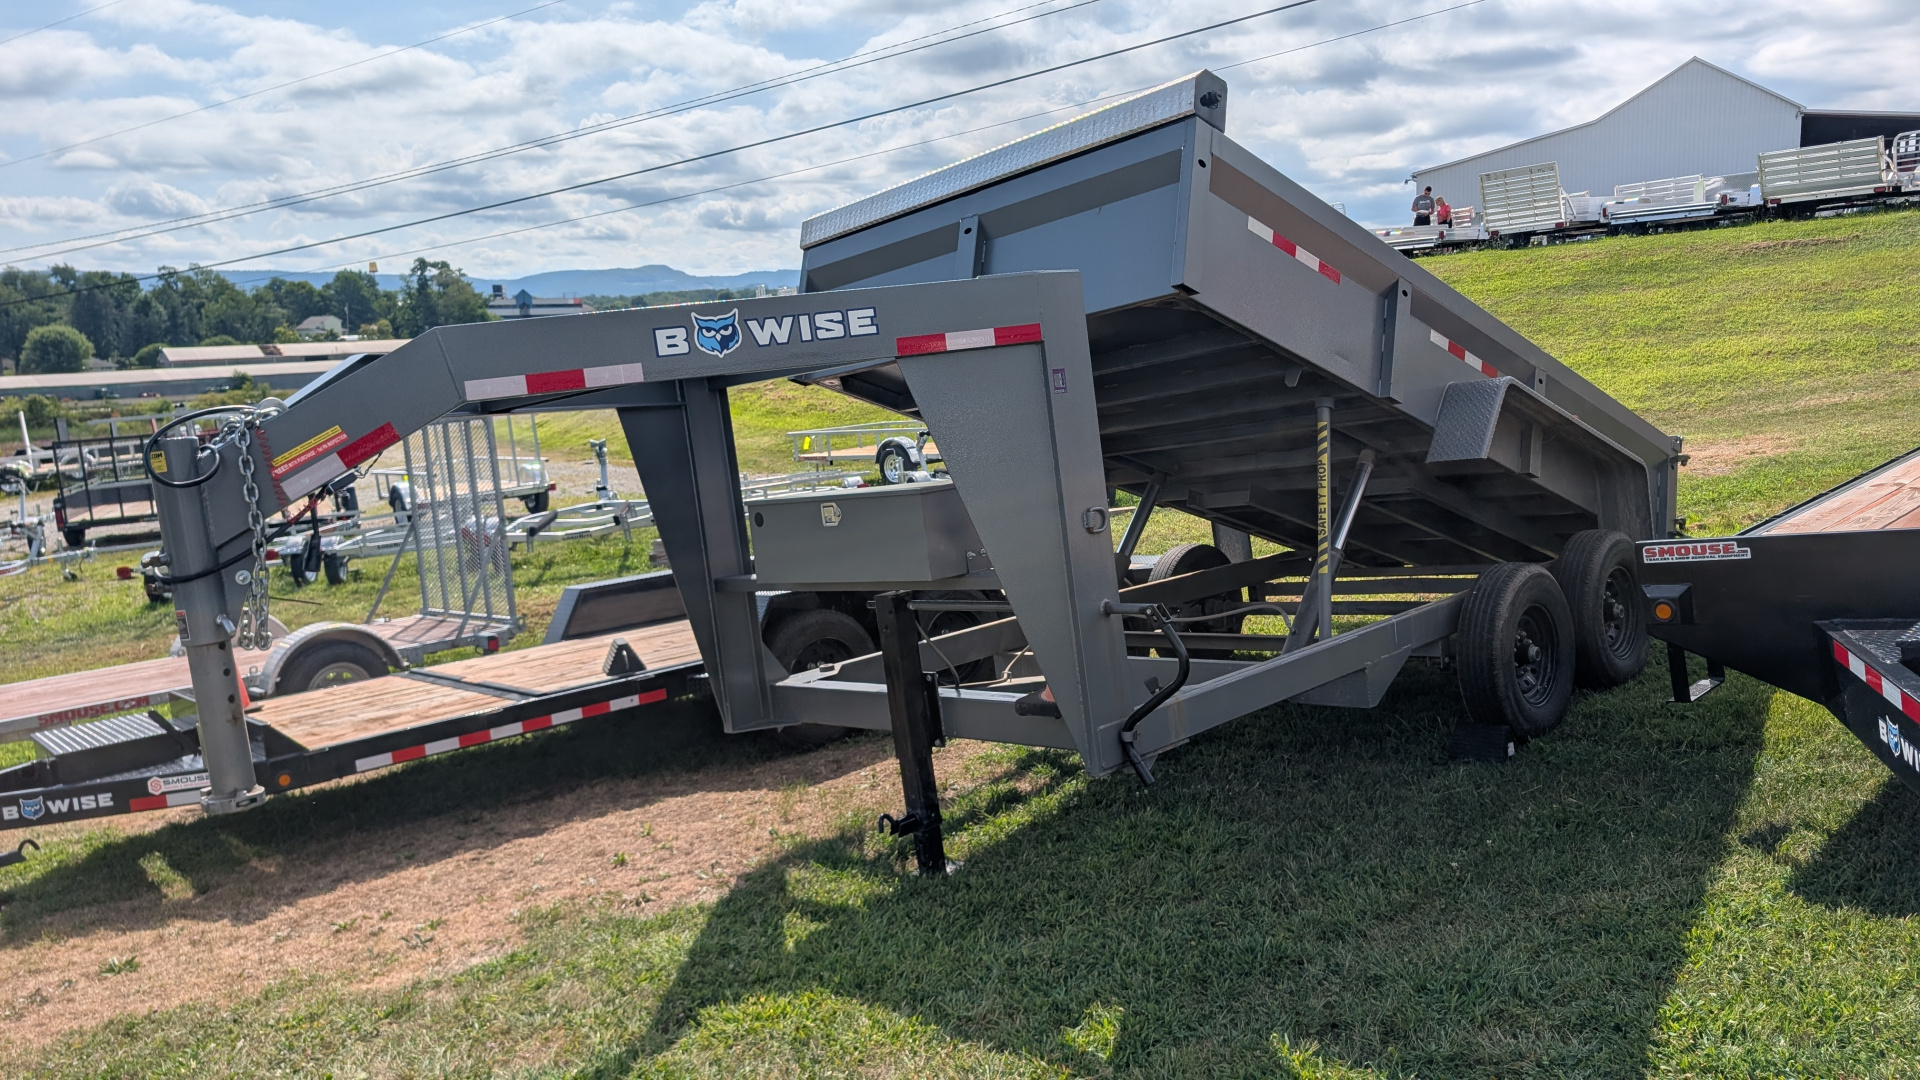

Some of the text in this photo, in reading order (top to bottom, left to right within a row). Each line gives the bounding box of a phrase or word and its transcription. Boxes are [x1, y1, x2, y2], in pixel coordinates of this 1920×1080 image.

[744, 306, 880, 347] WISE
[1318, 459, 1327, 536] SAFETY PROP
[46, 792, 115, 814] WISE
